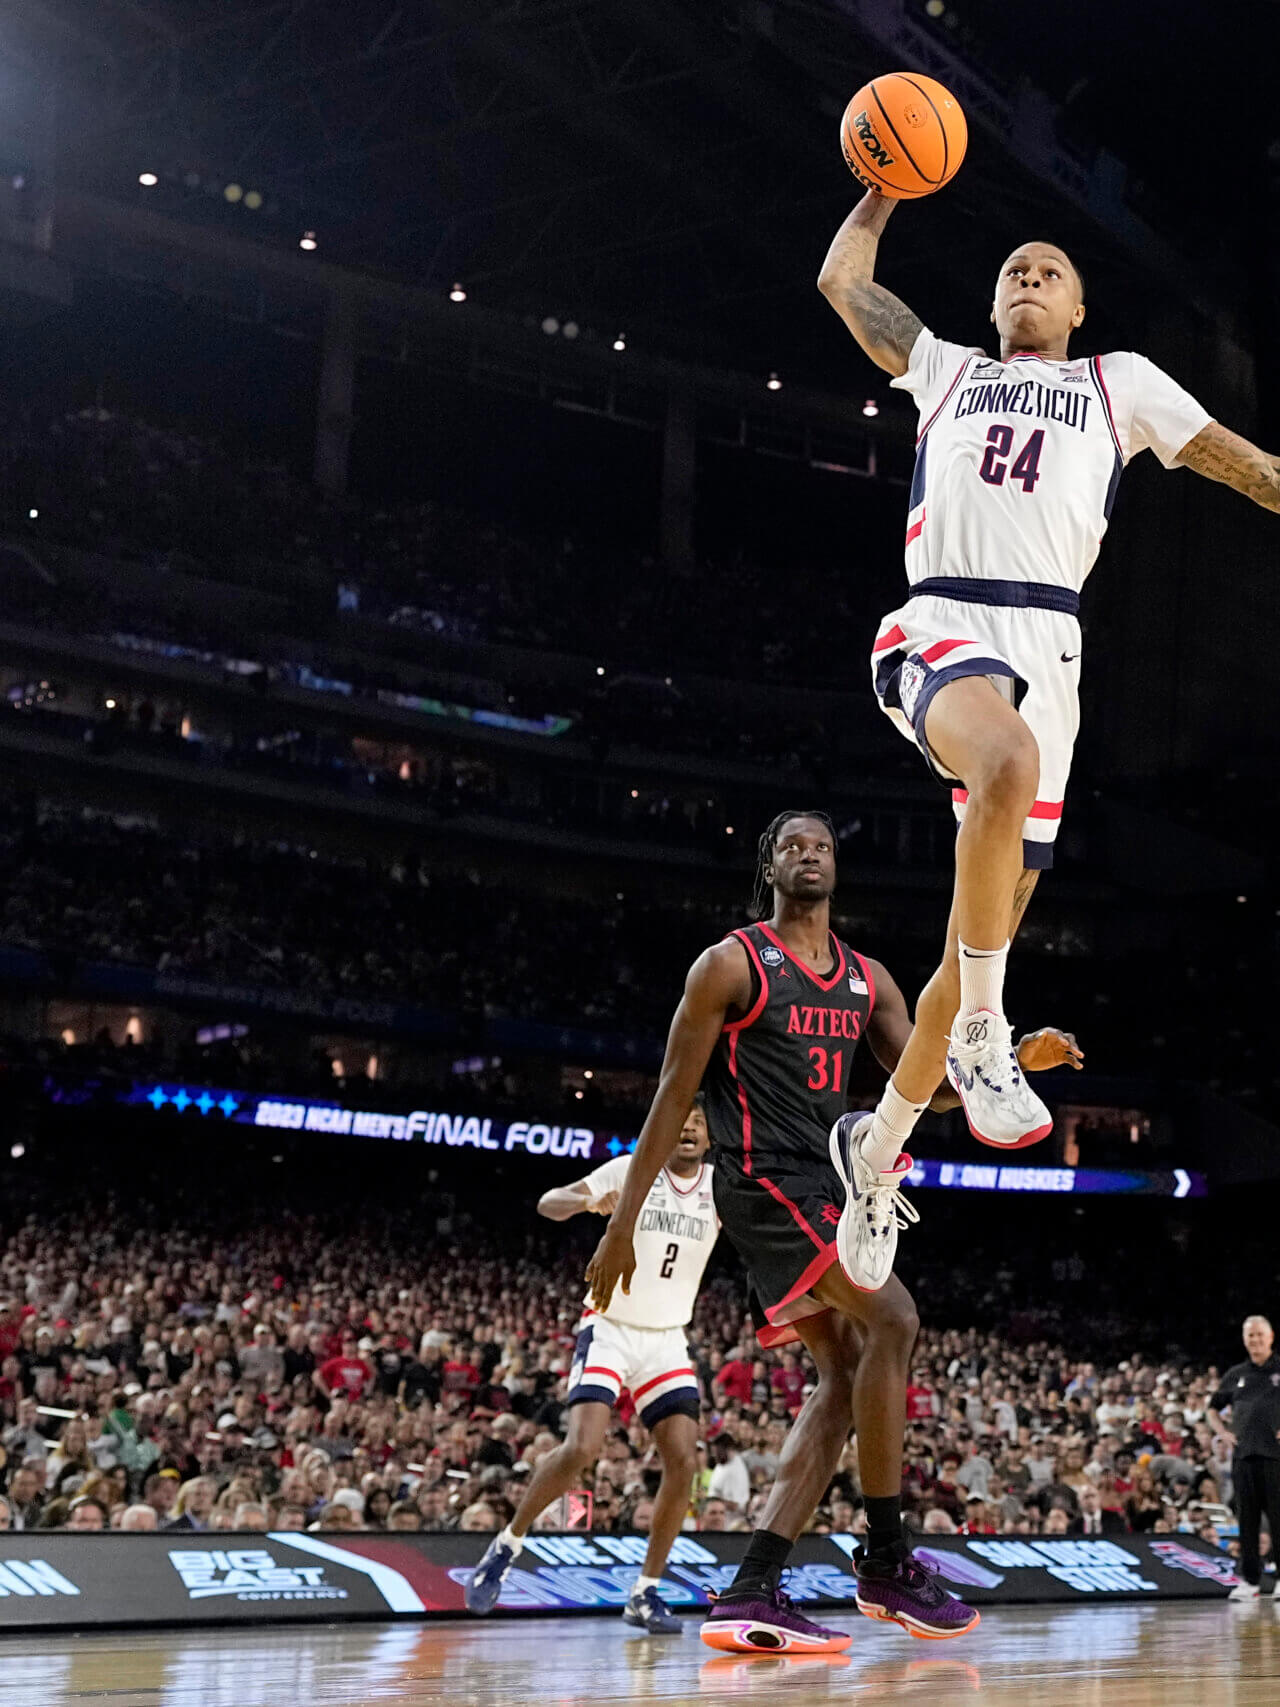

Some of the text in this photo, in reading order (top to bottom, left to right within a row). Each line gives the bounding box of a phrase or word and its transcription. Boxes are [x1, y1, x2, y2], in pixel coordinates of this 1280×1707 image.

[853, 111, 895, 168] NCAA
[954, 380, 1092, 433] CONNECTICUT
[978, 424, 1046, 493] 24
[787, 1005, 862, 1040] AZTECS
[807, 1046, 843, 1092] 31
[255, 1101, 305, 1129] 2023
[304, 1106, 353, 1135] NCAA
[404, 1110, 500, 1150] FINAL
[504, 1122, 595, 1159] FOUR
[998, 1166, 1076, 1192] HUSKIES
[659, 1242, 680, 1280] 2
[168, 1550, 275, 1571] BIG
[521, 1536, 615, 1565] THE
[177, 1567, 324, 1588] EAST
[237, 1590, 348, 1601] CONFERENCE
